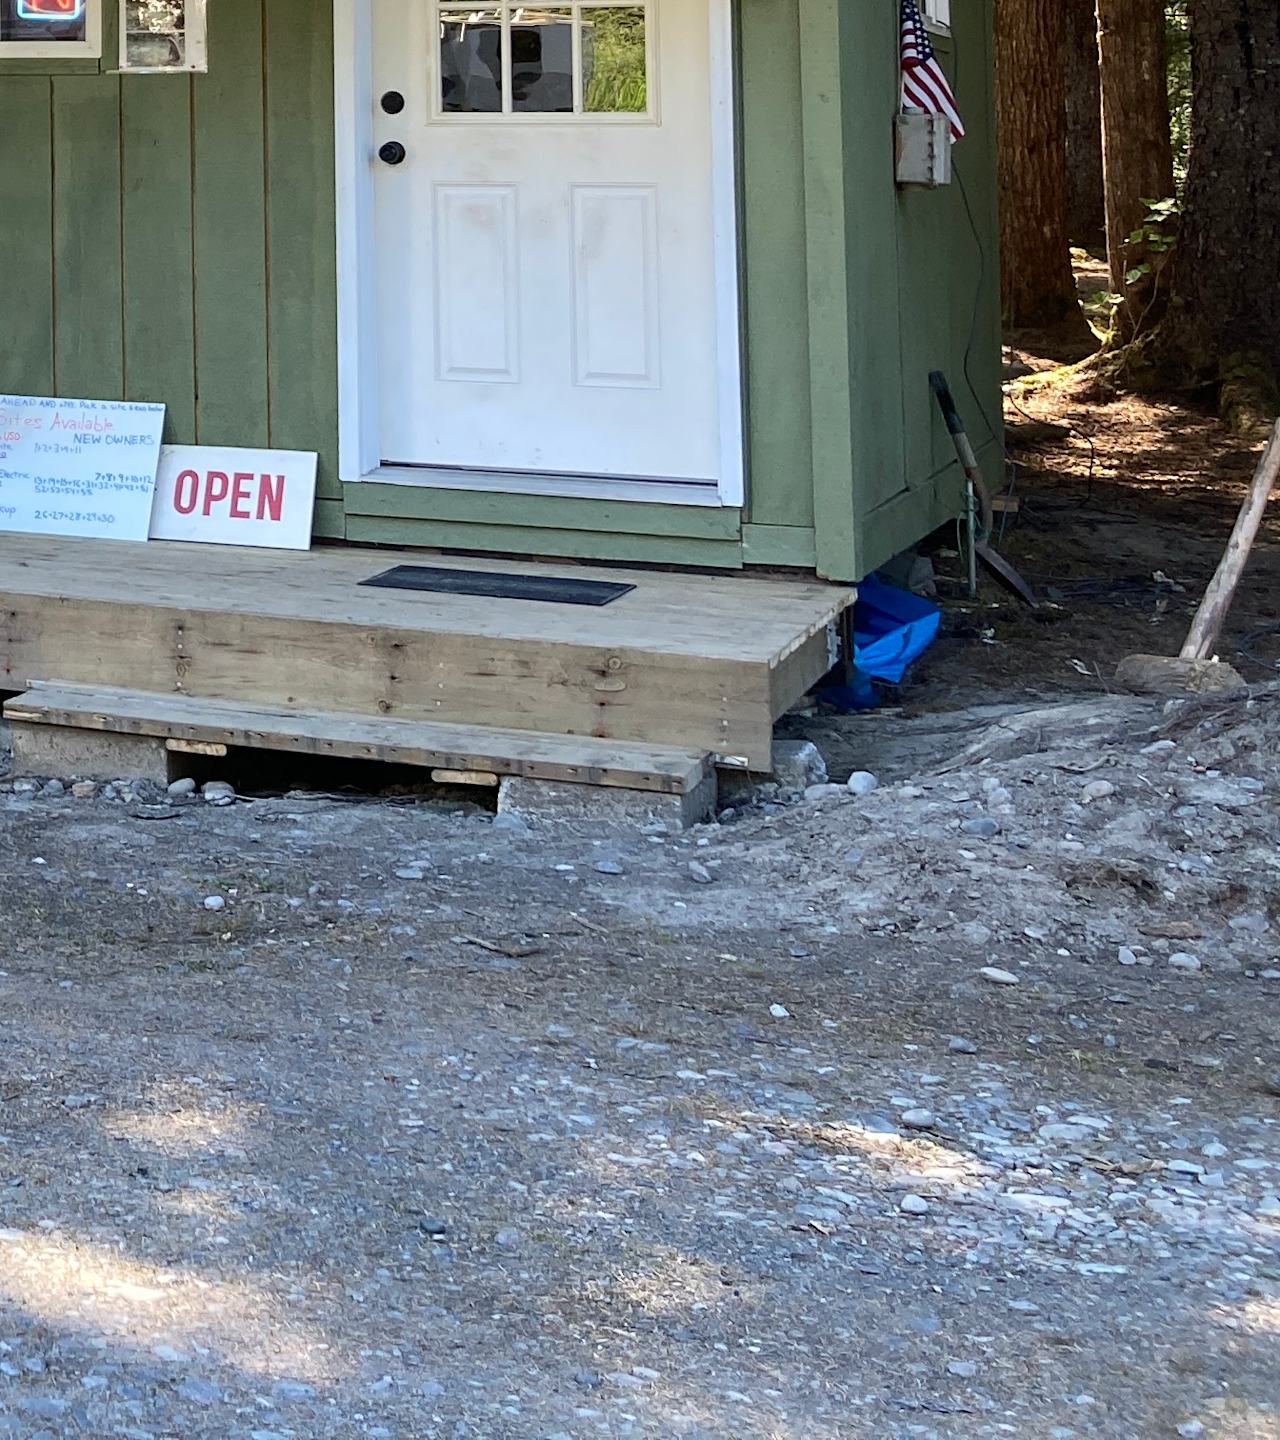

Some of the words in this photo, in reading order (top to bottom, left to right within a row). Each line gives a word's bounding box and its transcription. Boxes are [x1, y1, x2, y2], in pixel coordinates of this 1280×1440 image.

[49, 411, 114, 433] Available
[3, 431, 21, 441] USD
[73, 433, 100, 445] NEW
[105, 434, 154, 446] OWNERS
[174, 470, 285, 521] OPEN
